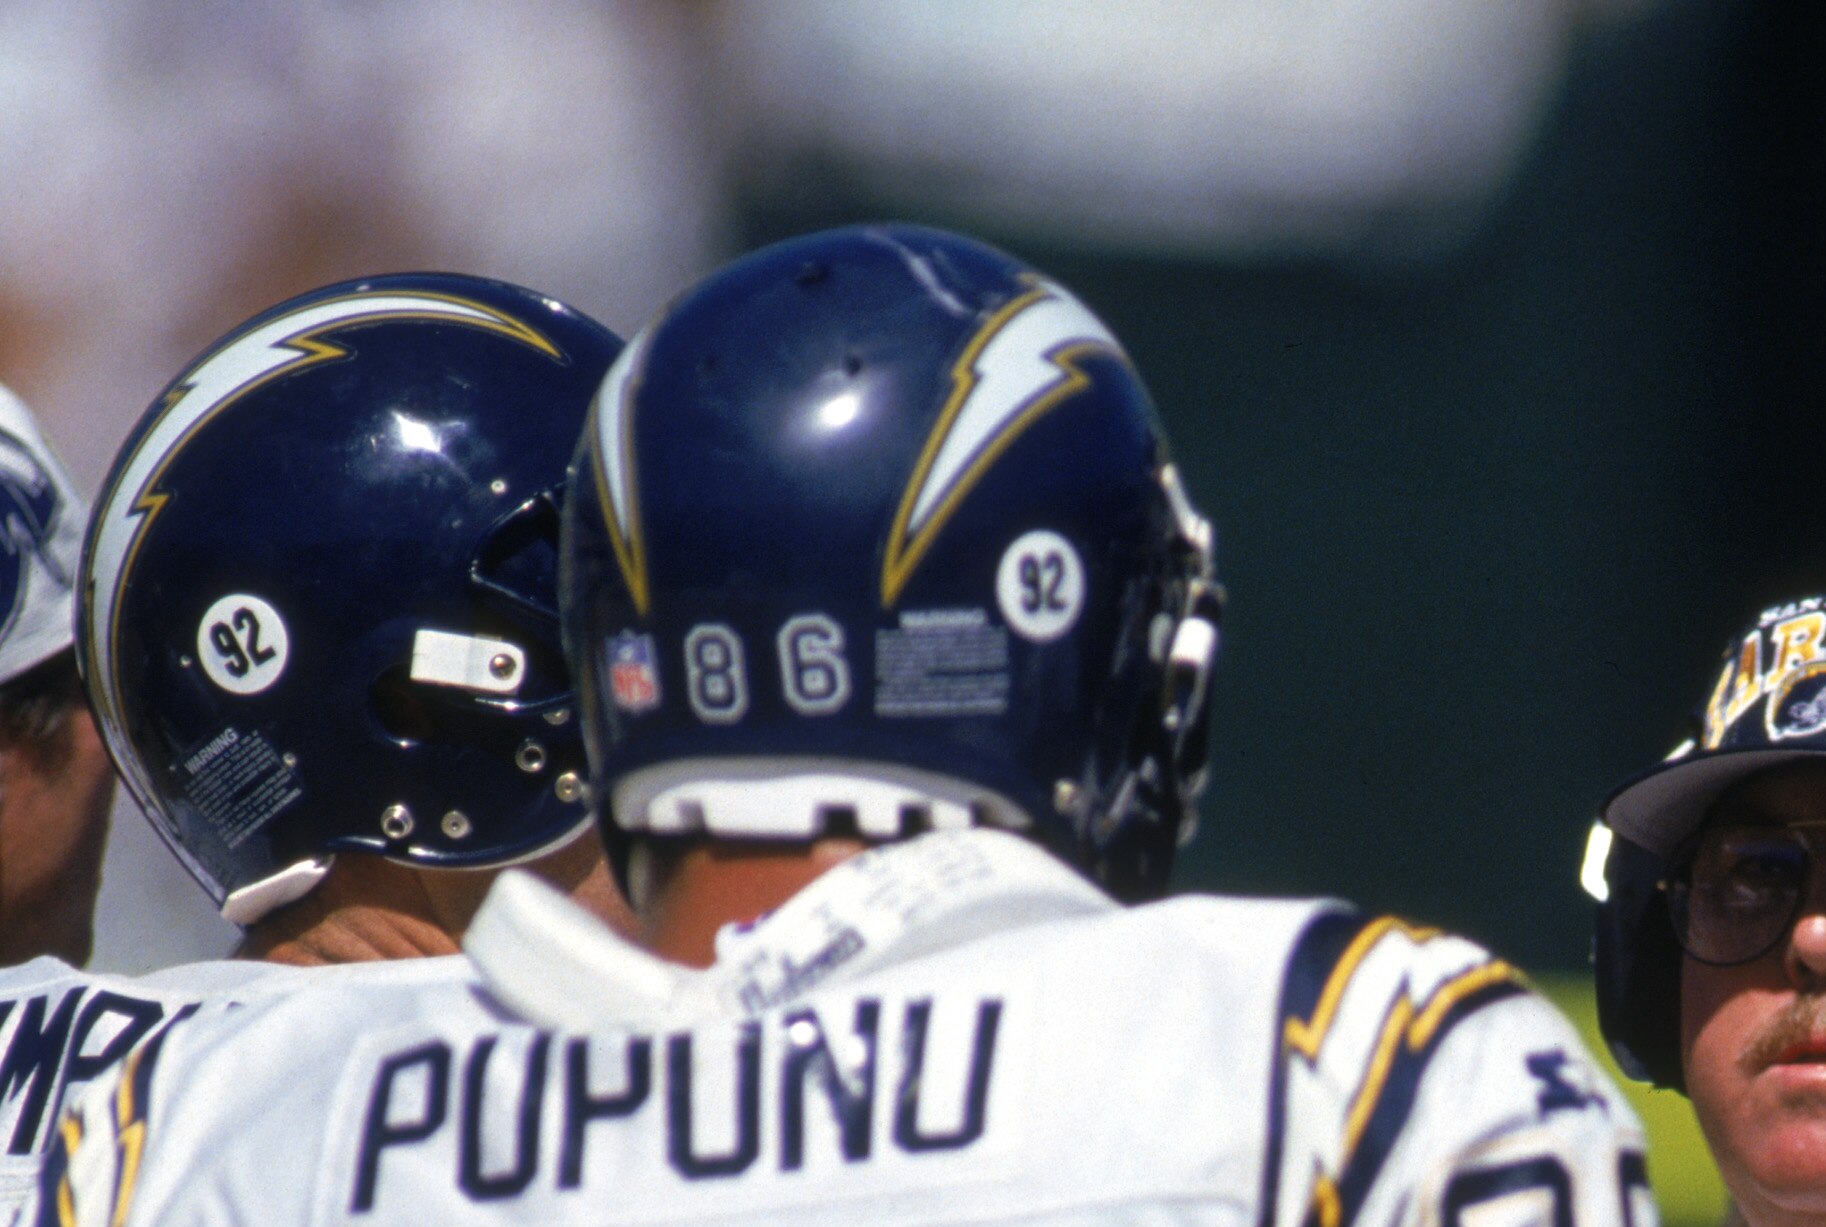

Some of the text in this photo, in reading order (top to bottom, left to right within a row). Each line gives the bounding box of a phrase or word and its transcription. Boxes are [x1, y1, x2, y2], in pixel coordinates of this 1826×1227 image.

[1018, 549, 1067, 616] 92
[1758, 597, 1823, 628] SAN
[209, 605, 277, 678] 92
[684, 612, 852, 724] 86
[184, 727, 239, 775] WARNING
[0, 984, 203, 1156] MP
[348, 996, 1004, 1216] PUPUNU
